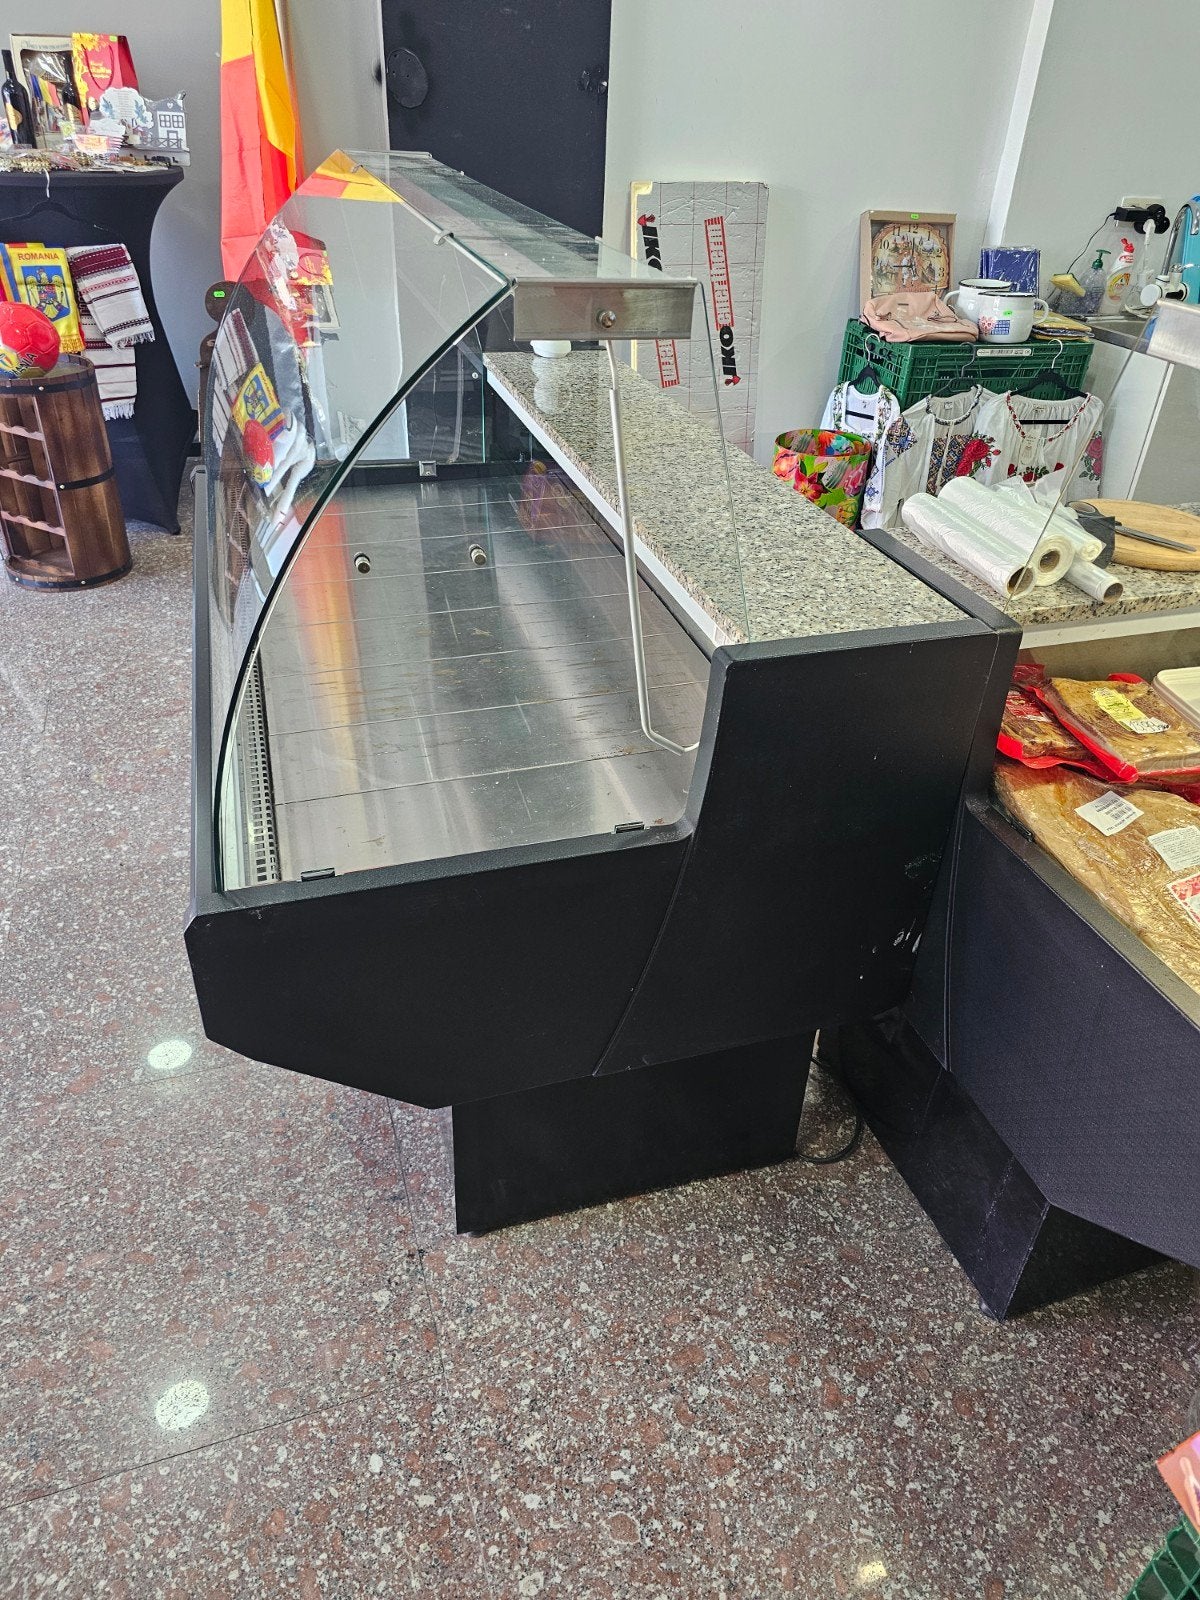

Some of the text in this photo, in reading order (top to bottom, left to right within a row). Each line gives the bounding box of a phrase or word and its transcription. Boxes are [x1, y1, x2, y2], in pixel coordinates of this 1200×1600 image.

[892, 225, 901, 236] 11
[908, 224, 919, 234] 12
[879, 239, 890, 250] 10
[17, 252, 60, 261] ROMANIA
[719, 326, 737, 376] IKO
